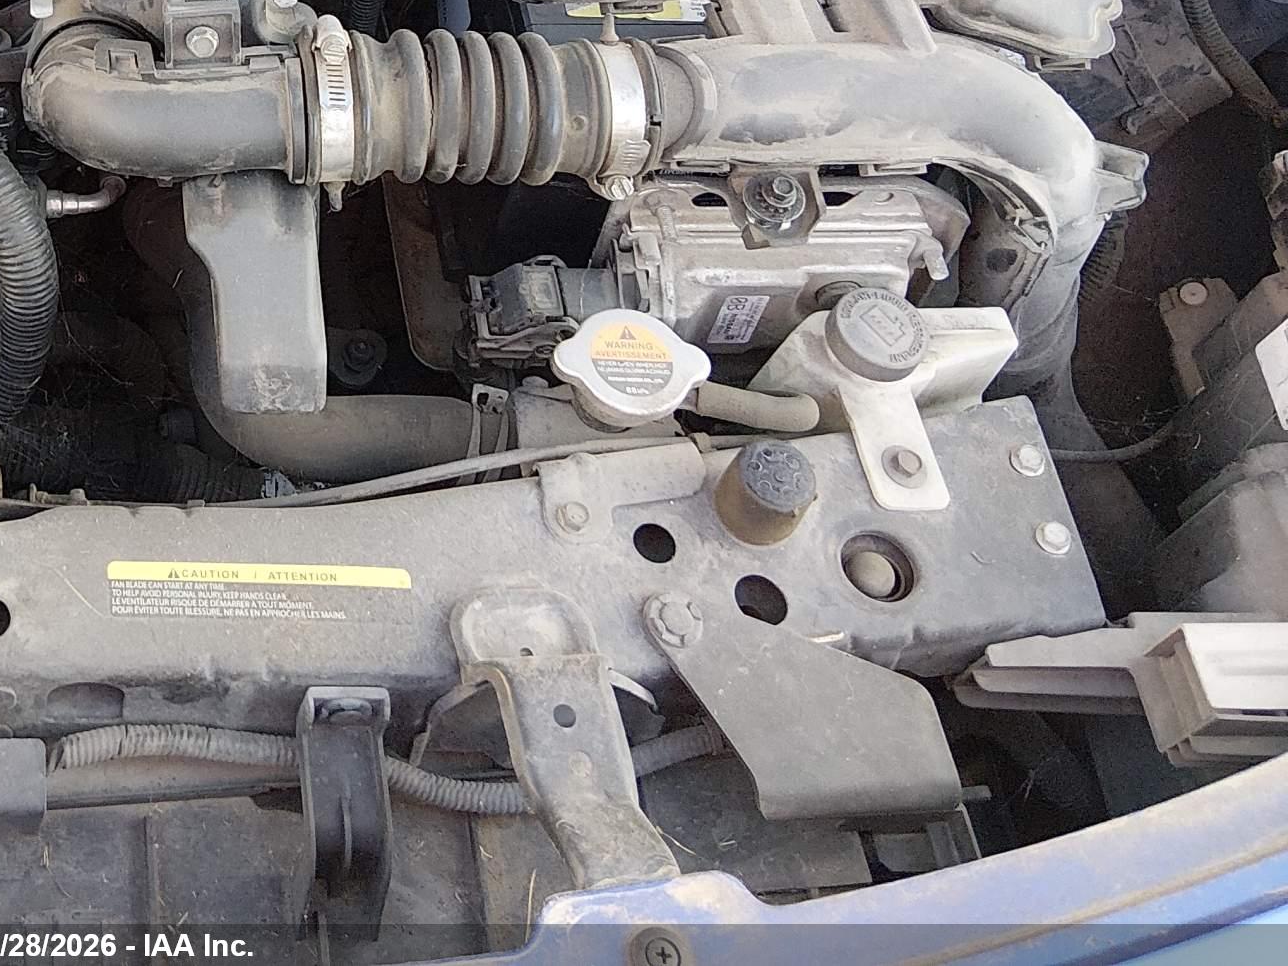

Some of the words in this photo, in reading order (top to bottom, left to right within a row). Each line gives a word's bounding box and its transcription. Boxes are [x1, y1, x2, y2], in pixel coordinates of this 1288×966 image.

[605, 340, 654, 350] WARNING
[595, 350, 667, 360] AVERTISSEMENT
[181, 569, 239, 579] CAUTION
[268, 571, 337, 581] ATTENTION
[111, 580, 125, 589] FAN
[126, 580, 147, 589] BLADE
[148, 581, 163, 590] CAN
[164, 581, 183, 590] START
[184, 582, 193, 590] AT
[194, 582, 210, 591] ANY
[111, 588, 122, 597] TO
[123, 589, 139, 597] HELP
[140, 589, 161, 598] AVOID
[162, 589, 195, 598] PERSONAL
[223, 591, 238, 599] KEEP
[239, 592, 264, 600] HANDS
[112, 597, 120, 605] LE
[121, 597, 170, 607] VENTILATEUR
[171, 598, 198, 608] RISQUE
[199, 599, 208, 608] DE
[259, 600, 277, 609] TOUT
[112, 605, 133, 614] POUR
[160, 606, 184, 616] TOUTE
[224, 608, 234, 617] NE
[235, 608, 248, 617] PAS
[250, 608, 260, 617] EN
[307, 610, 320, 619] LES
